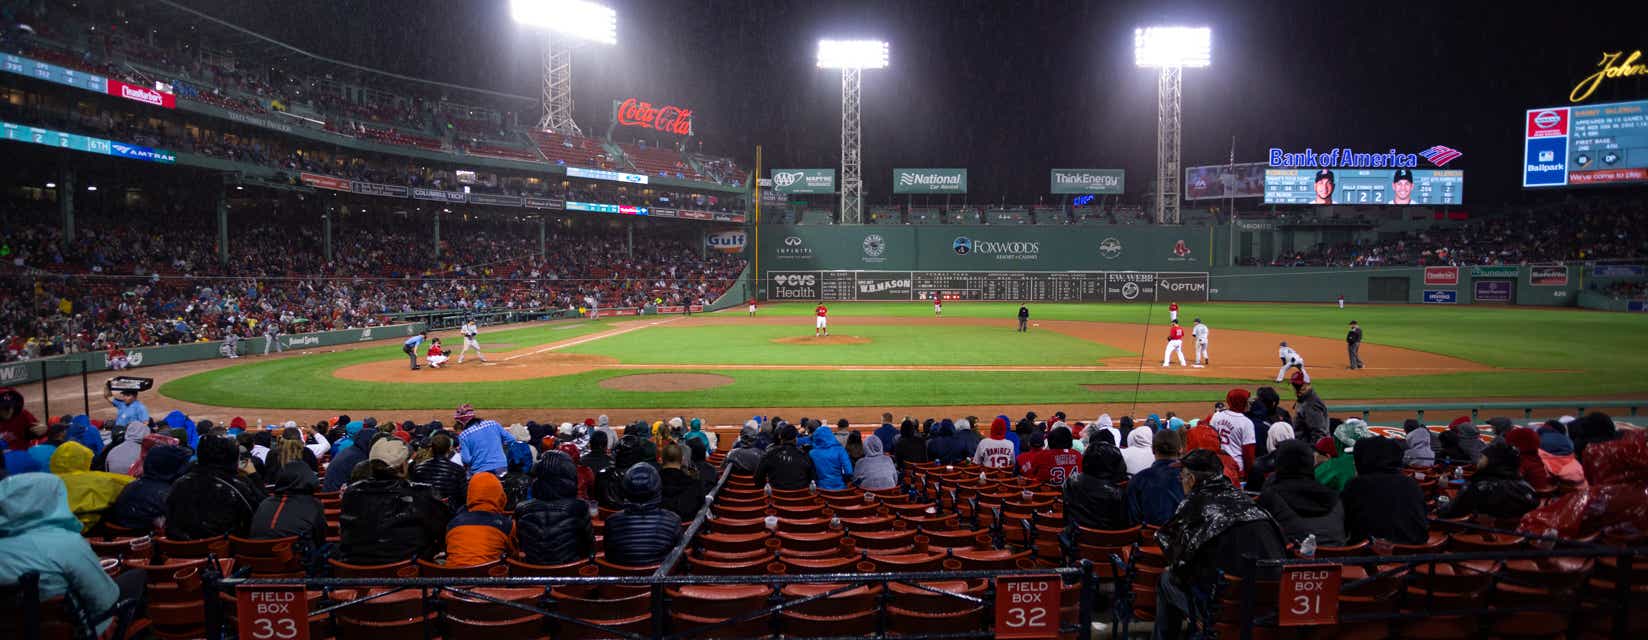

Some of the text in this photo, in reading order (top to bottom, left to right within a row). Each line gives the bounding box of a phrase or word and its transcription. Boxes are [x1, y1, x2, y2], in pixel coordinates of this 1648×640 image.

[618, 98, 689, 135] Coca-Cola
[90, 140, 108, 151] 6TH
[130, 150, 175, 161] AMTRAK
[1269, 148, 1417, 167] Bank of America
[1528, 163, 1564, 172] Ballpark
[914, 173, 960, 184] National
[1056, 173, 1118, 186] ThinkEnergy
[708, 234, 745, 245] Gulf
[974, 240, 1039, 254] FOXWOODS
[788, 274, 816, 286] CVS
[776, 286, 816, 298] Health
[1170, 283, 1205, 292] OPTUM
[984, 448, 1012, 456] RAMIREZ
[1050, 467, 1080, 486] 34
[1289, 571, 1329, 580] FIELD
[1007, 581, 1048, 592] FIELD
[1295, 581, 1323, 591] BOX
[251, 592, 295, 602] FIELD
[1012, 593, 1042, 603] BOX
[257, 603, 289, 614] BOX
[1291, 595, 1321, 615] 31
[1006, 607, 1047, 627] 32
[252, 618, 297, 639] 33
